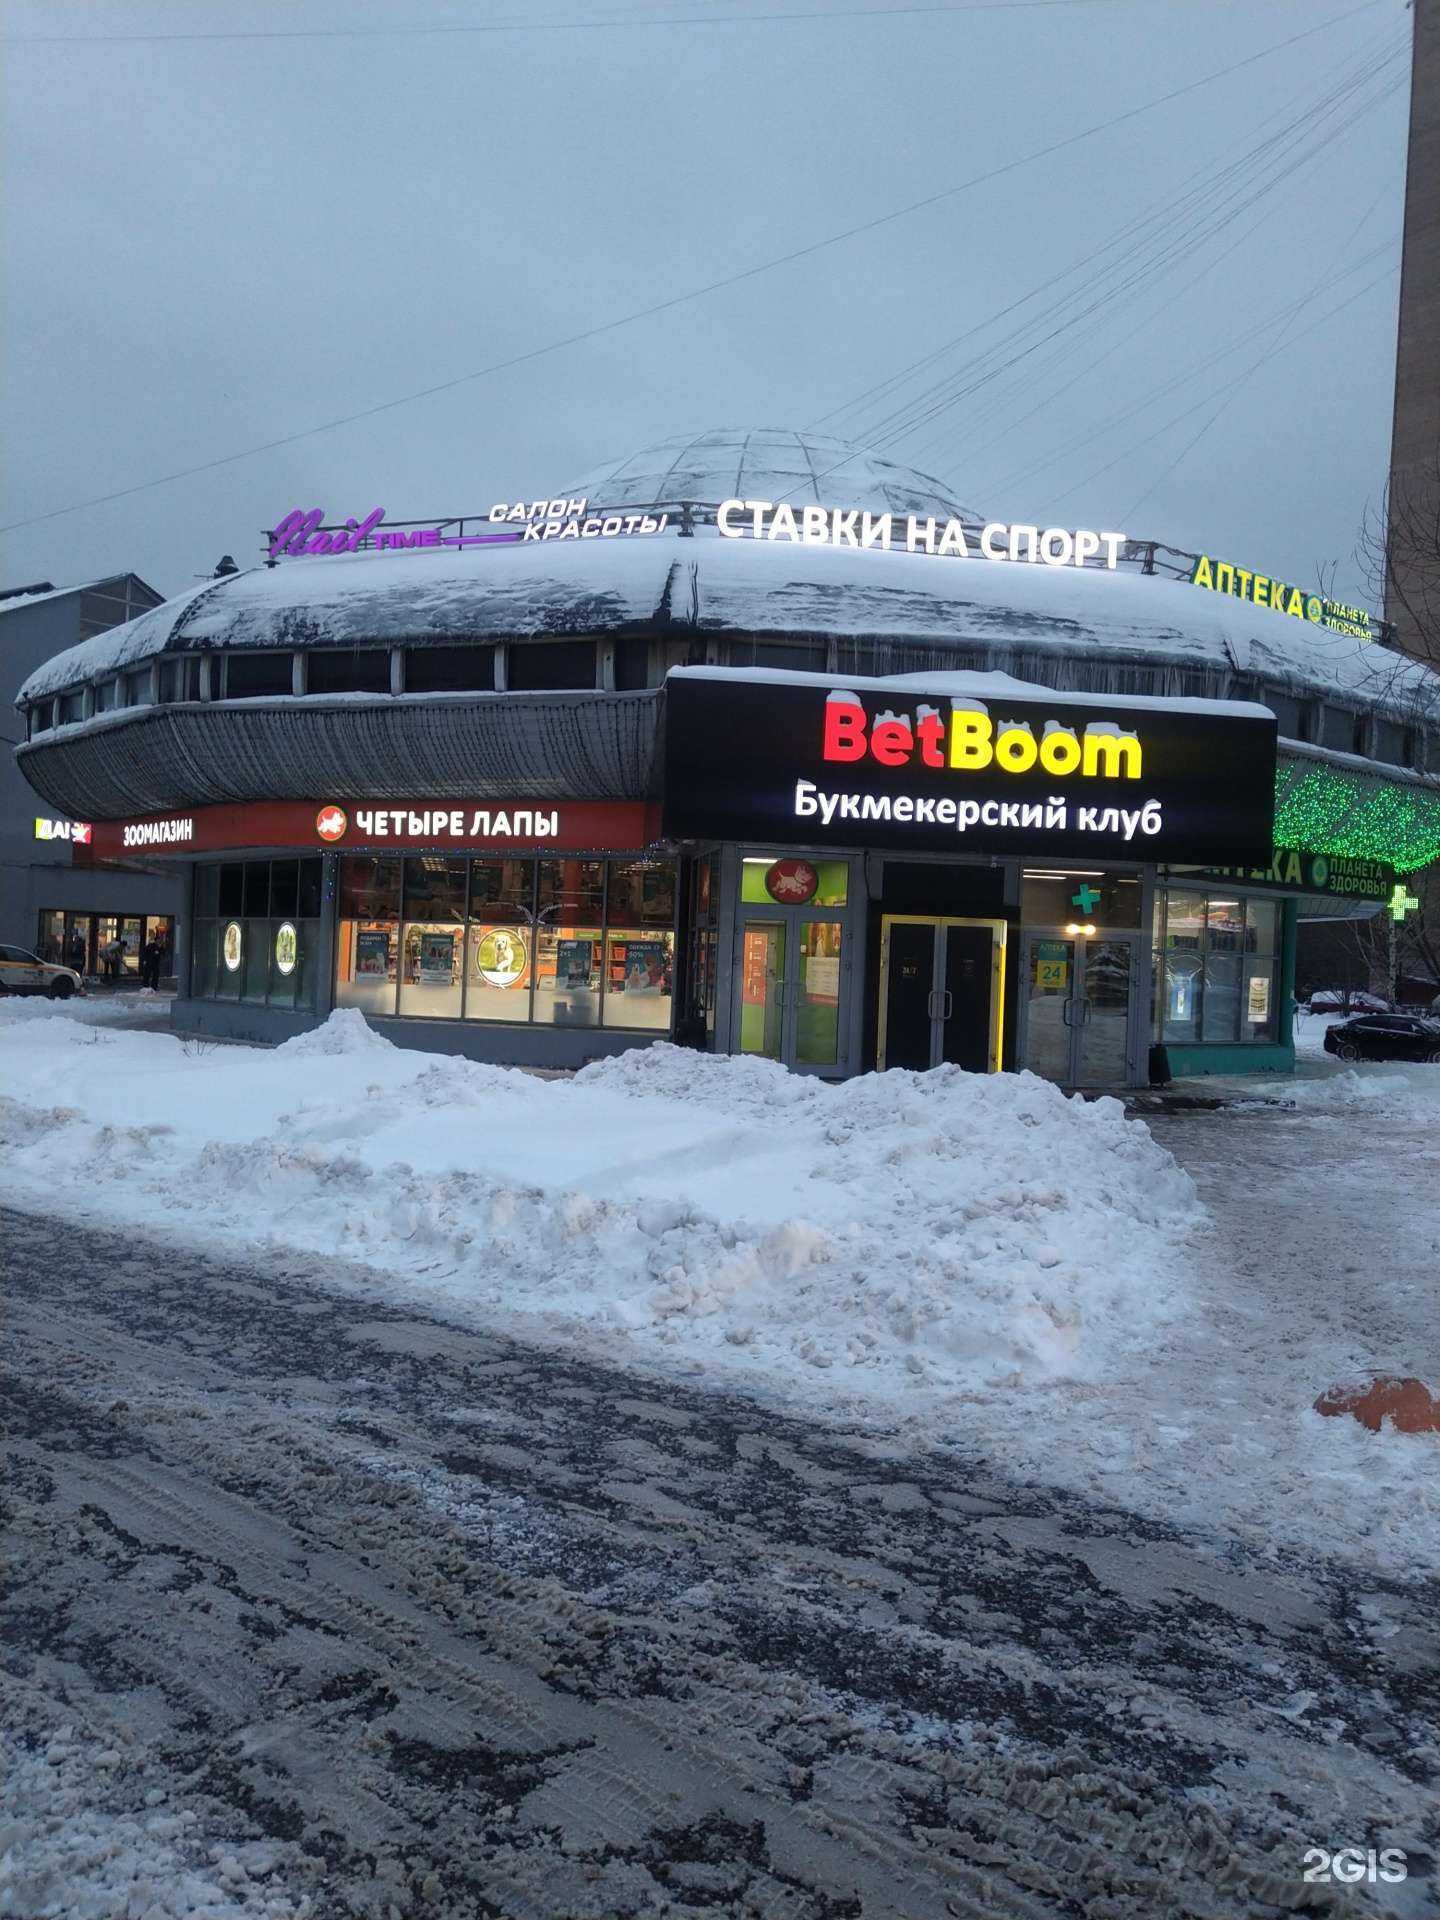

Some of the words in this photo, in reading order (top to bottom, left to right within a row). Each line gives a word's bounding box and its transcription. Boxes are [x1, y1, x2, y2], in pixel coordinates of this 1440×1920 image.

[489, 498, 587, 521] САЛОН
[270, 506, 386, 555] Nail
[373, 528, 440, 549] TIME
[522, 514, 668, 540] КРАСОТЫ
[716, 499, 892, 550] СТАВКИ
[907, 515, 968, 557] НА
[980, 522, 1126, 569] СПОРТ
[1193, 554, 1304, 619] АПТЕКА
[1327, 601, 1370, 626] ПЛАНЕТА
[1325, 616, 1372, 643] ЗДОРОВЬЯ
[823, 700, 1143, 779] BetBoom
[356, 811, 464, 836] ЧЕТЫРЕ
[470, 811, 558, 836] ЛАПЫ
[794, 783, 1067, 832] Букмекерский
[1078, 803, 1163, 841] клуб
[123, 818, 193, 847] ЗООМАГАЗИН
[1329, 858, 1384, 879] ПЛАНЕТА
[1329, 875, 1387, 896] ЗДОРОВЬЯ
[1043, 966, 1061, 980] 24
